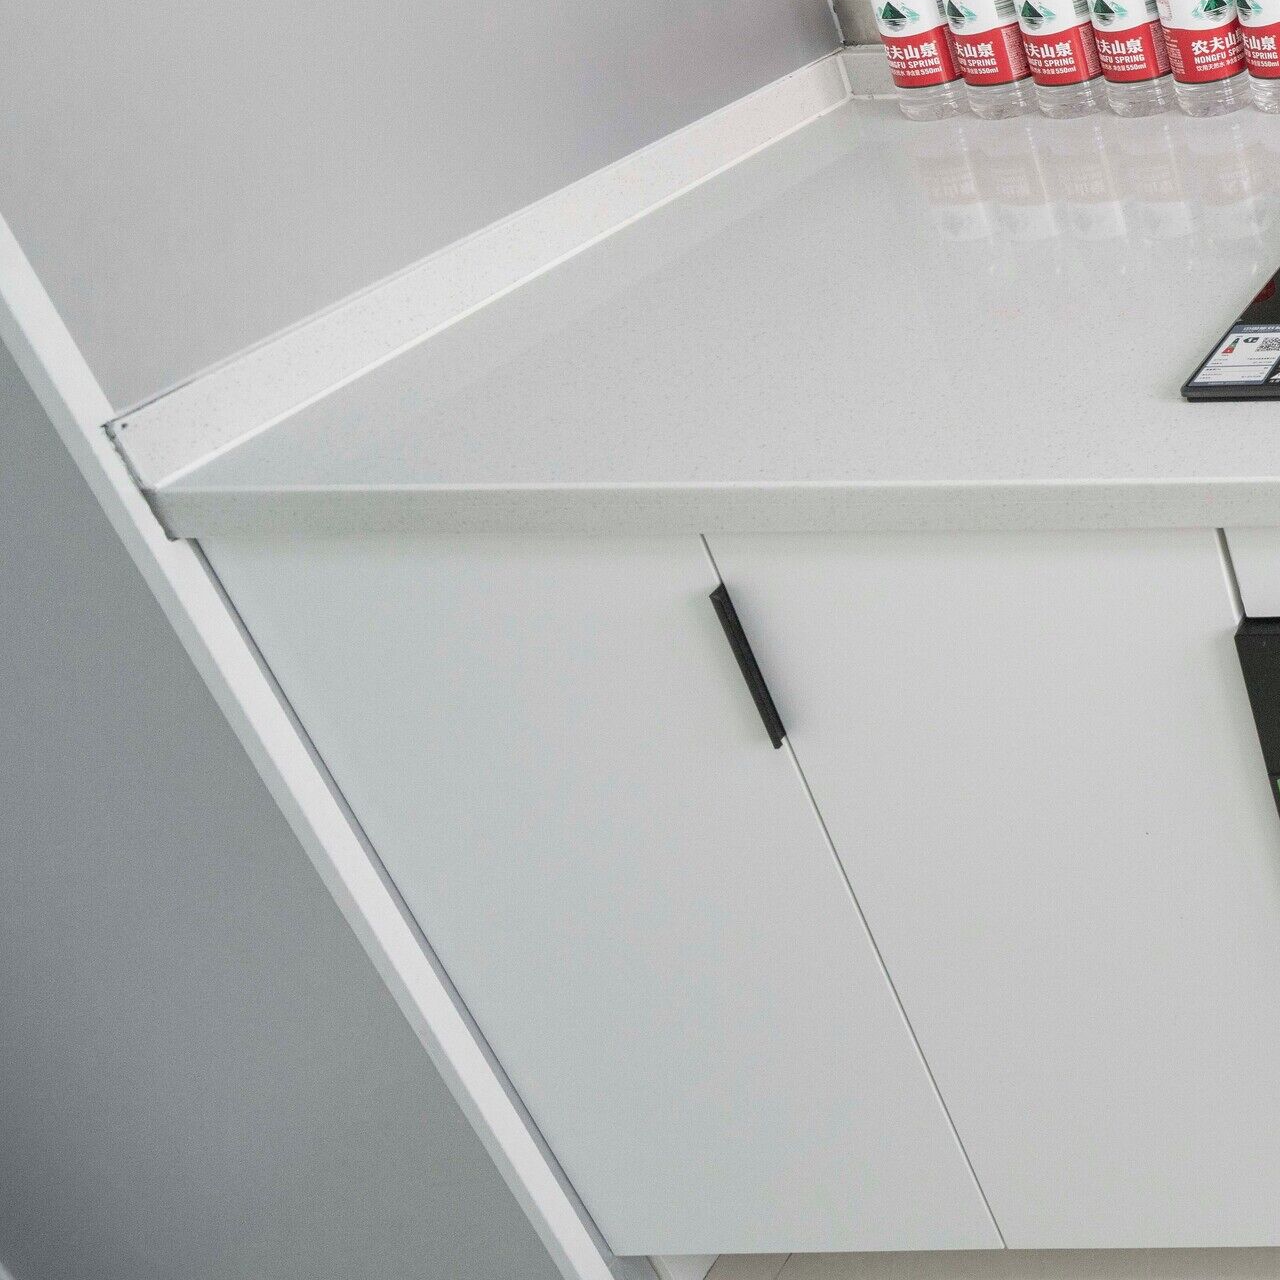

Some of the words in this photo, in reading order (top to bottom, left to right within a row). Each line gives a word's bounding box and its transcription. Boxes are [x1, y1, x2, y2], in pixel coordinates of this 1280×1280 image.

[1242, 33, 1277, 51] 夫山泉
[954, 41, 995, 58] 夫山泉
[1114, 53, 1145, 64] SPRING
[1194, 51, 1227, 65] NONGFU
[1252, 51, 1279, 60] SPRING
[908, 57, 941, 69] SPRING
[967, 58, 997, 67] SPRING
[1044, 57, 1075, 68] SPRING
